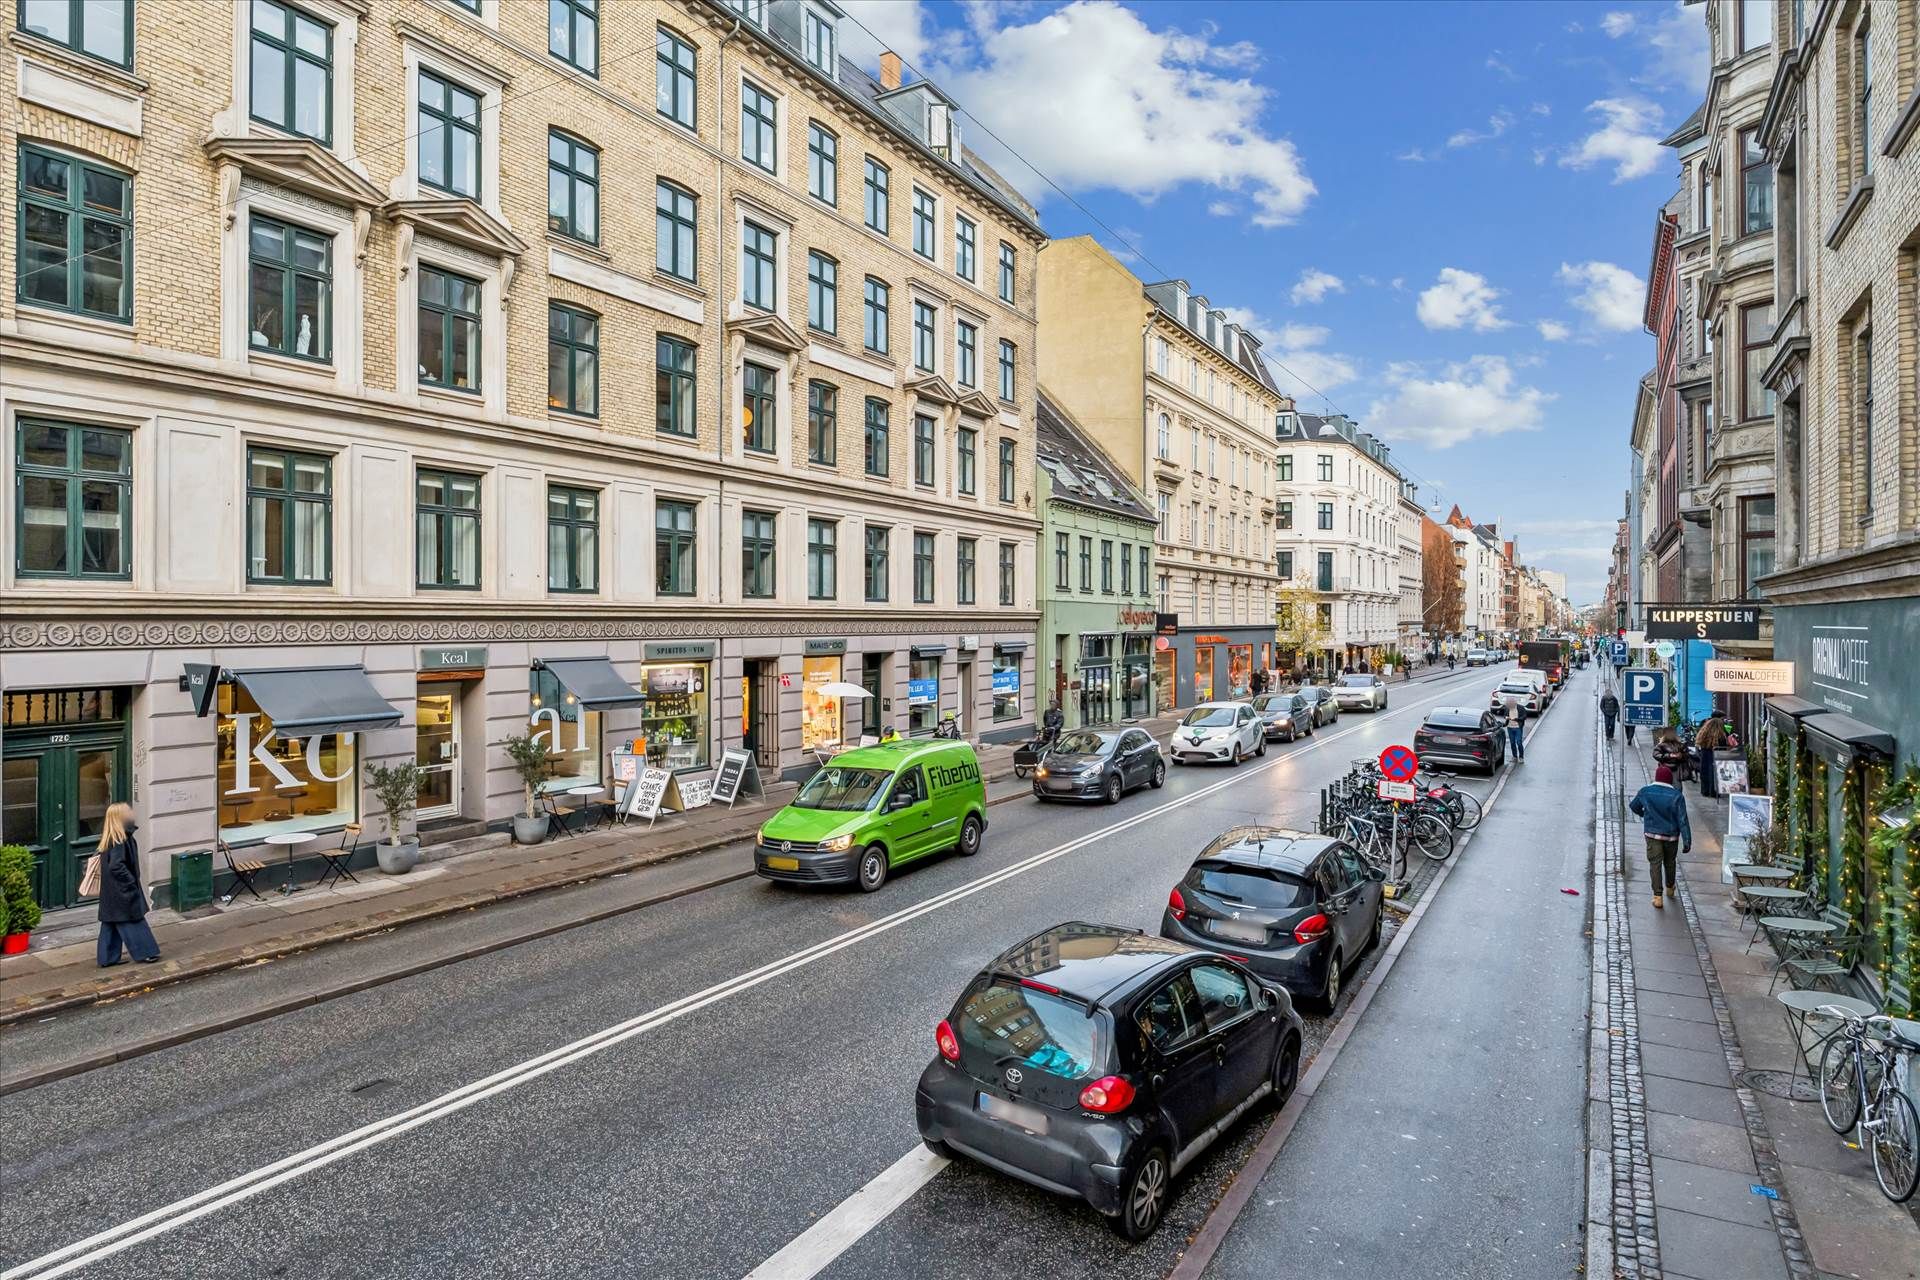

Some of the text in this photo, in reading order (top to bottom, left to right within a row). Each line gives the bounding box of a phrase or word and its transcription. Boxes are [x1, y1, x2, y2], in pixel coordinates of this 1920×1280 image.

[1653, 610, 1753, 622] KLIPPESTUEN
[1697, 623, 1707, 638] S
[656, 647, 687, 655] SPIRITUS
[1614, 643, 1624, 654] P
[440, 650, 468, 664] Kcal
[191, 674, 204, 685] Kcal
[1713, 670, 1787, 681] ORIGINALCOFFEE
[1633, 675, 1655, 701] P
[927, 760, 980, 790] Fiberby
